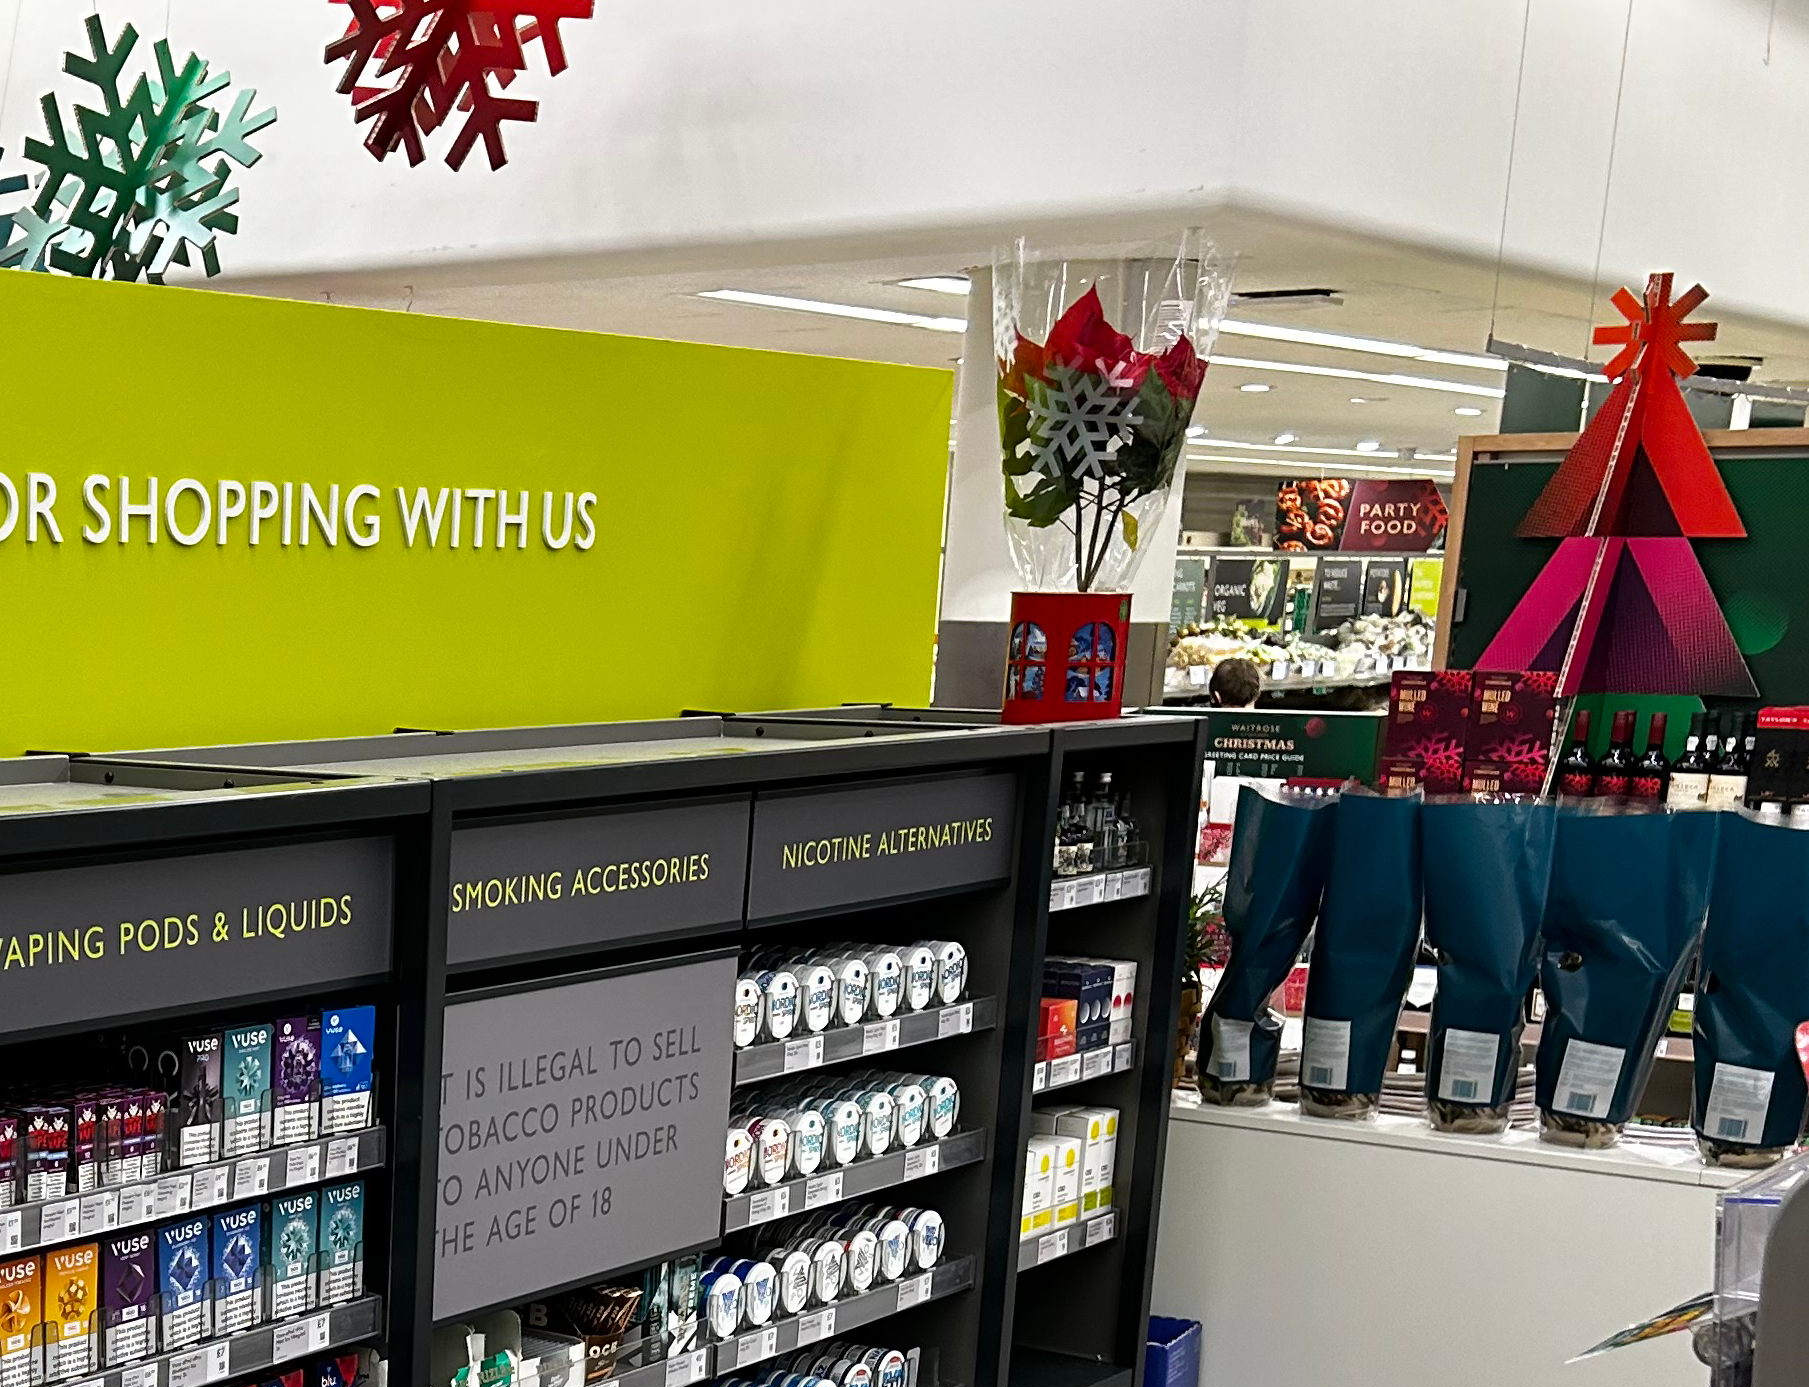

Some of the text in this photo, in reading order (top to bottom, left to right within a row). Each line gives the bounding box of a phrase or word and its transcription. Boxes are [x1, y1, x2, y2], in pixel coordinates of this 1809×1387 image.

[81, 472, 381, 548] SHOPPING
[397, 486, 529, 550] WITH
[541, 490, 598, 551] US
[1359, 502, 1422, 518] PARTY
[1360, 520, 1418, 535] FOOD
[1213, 599, 1228, 615] VEG
[1214, 583, 1247, 598] ORGANIC
[1214, 737, 1295, 750] CHRISTMAS
[1231, 723, 1282, 734] WAITROSE
[781, 816, 993, 871] NICOTINE ALTERNATIVES
[452, 852, 711, 914] SMOKING ACCESSORIES
[118, 913, 200, 957] PODS
[212, 911, 231, 943] &
[241, 893, 354, 942] LIQUIDS
[438, 1025, 701, 1107] T IS ILLEGAL TO SELL
[438, 1072, 700, 1156] OBACCO PRODUCTS
[437, 1124, 678, 1206] O ANYONE UNDER
[435, 1189, 613, 1260] HE AGE OF 18
